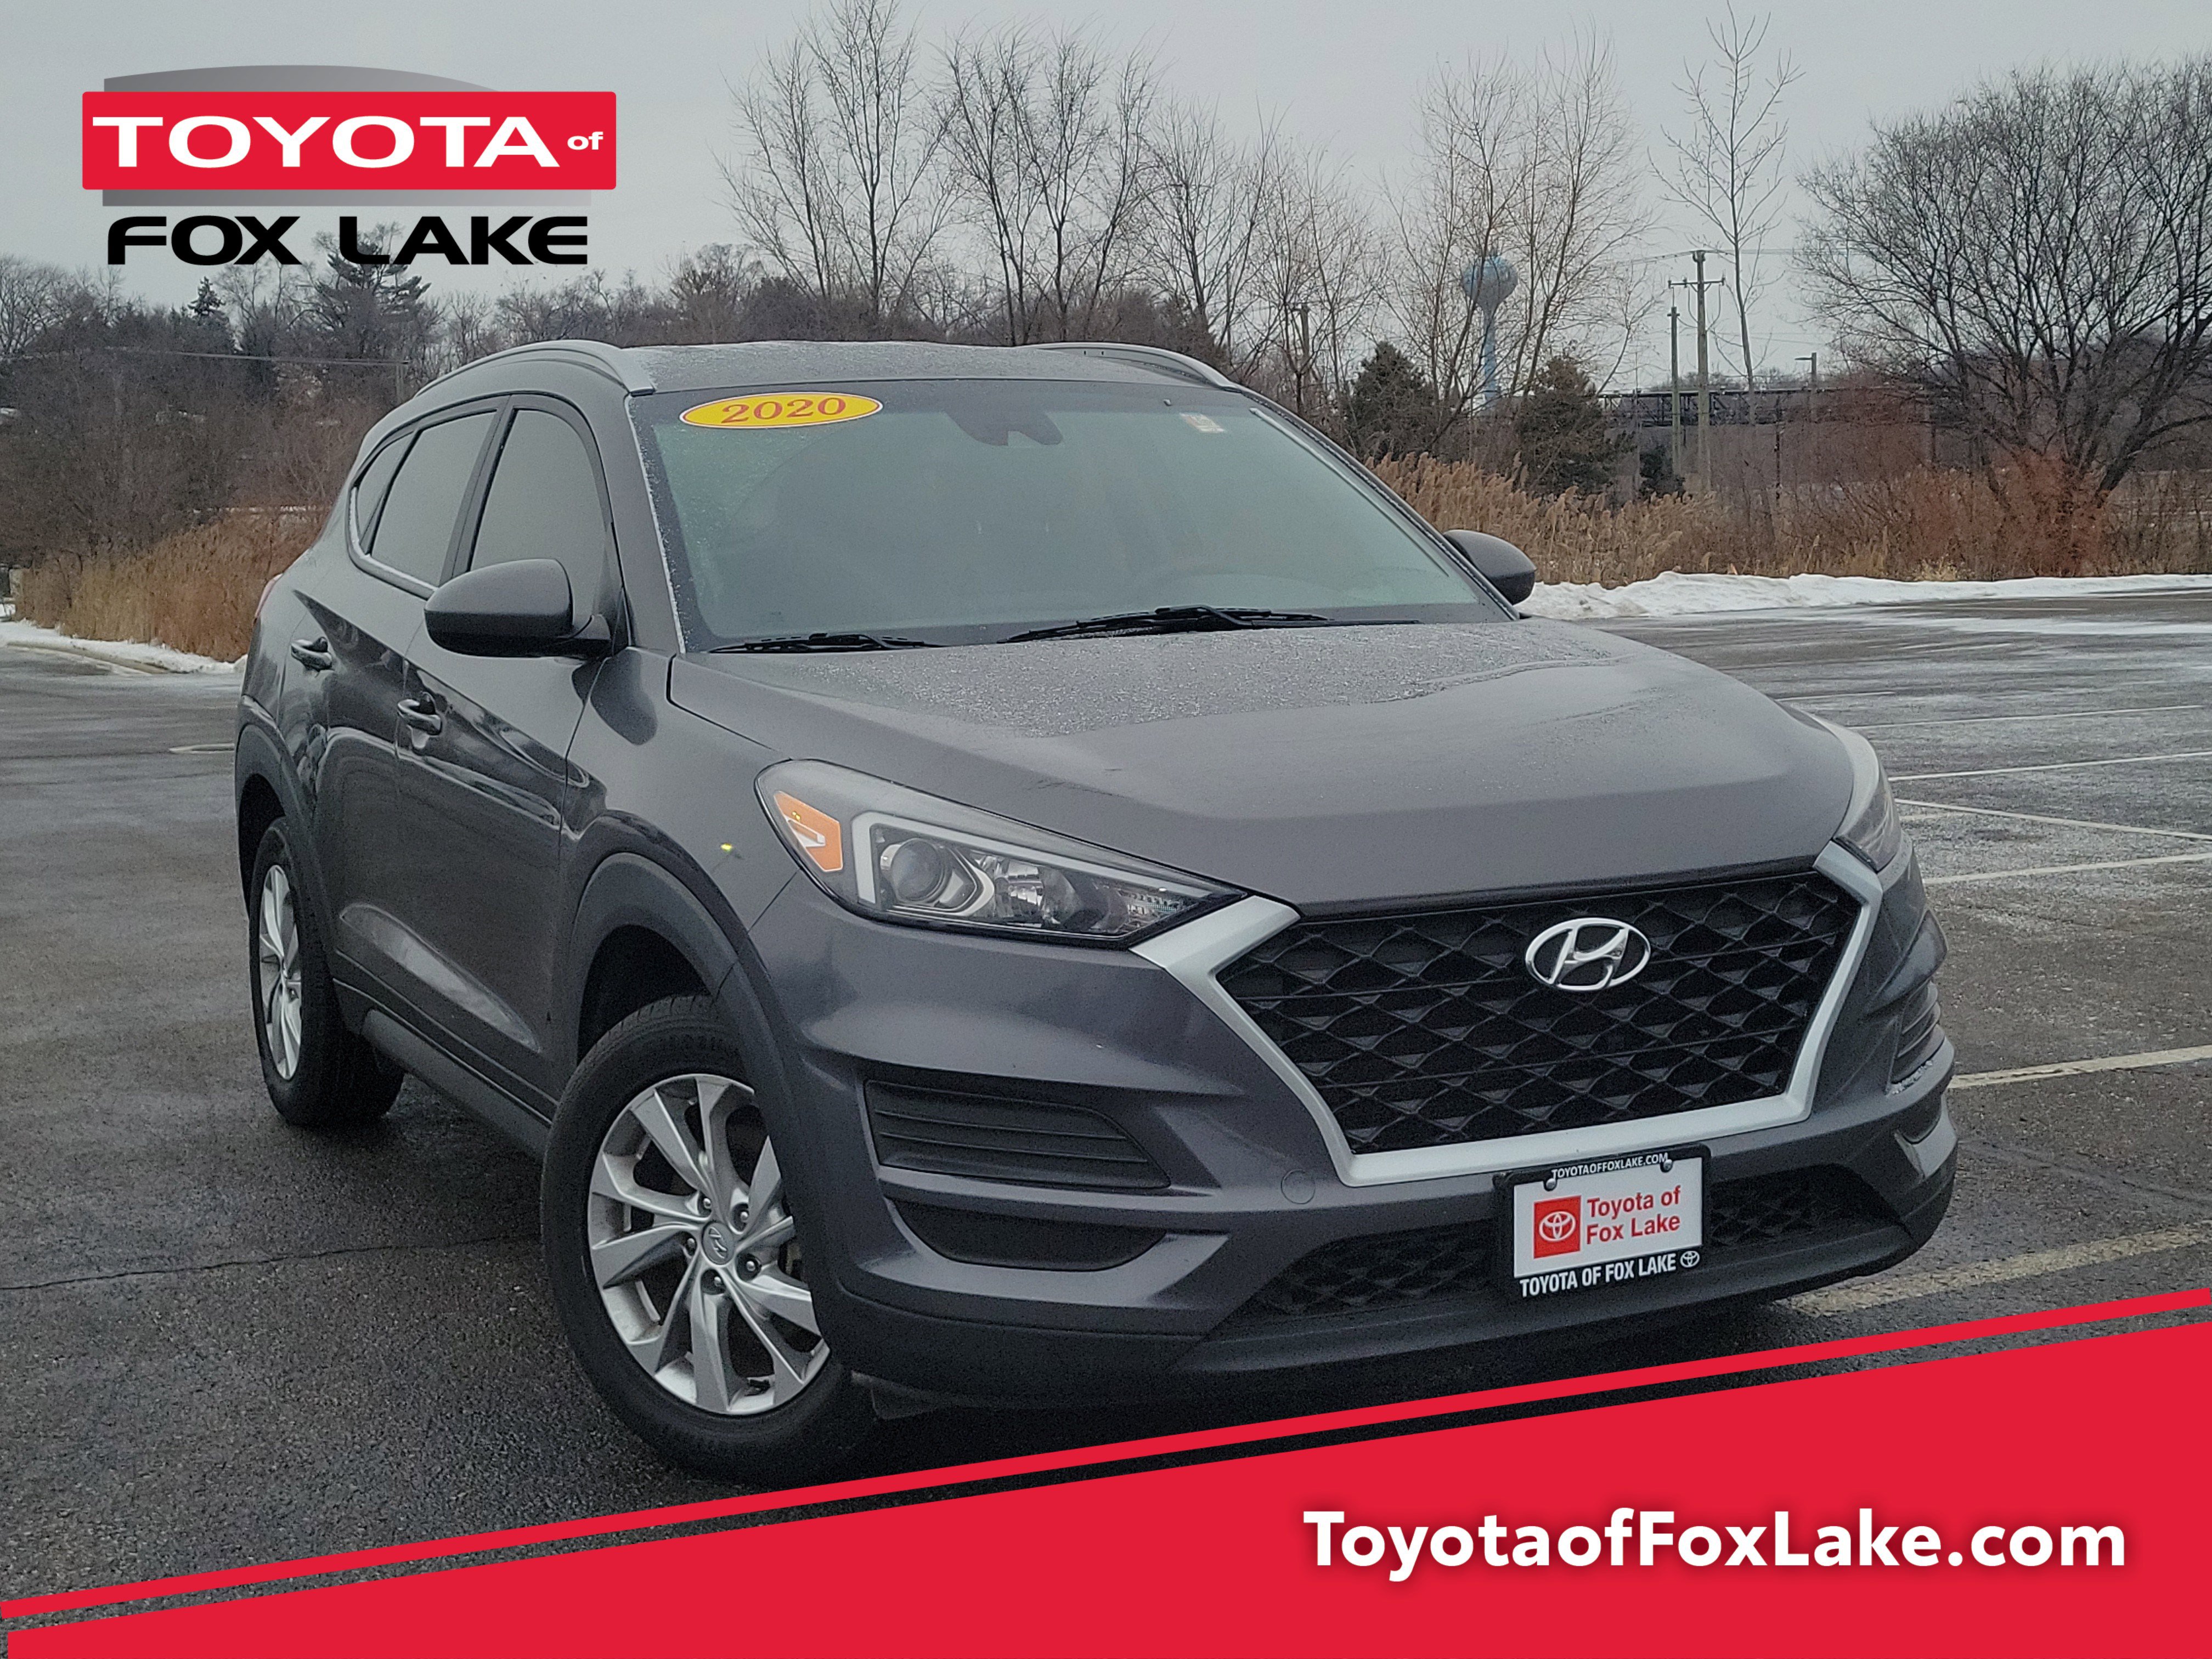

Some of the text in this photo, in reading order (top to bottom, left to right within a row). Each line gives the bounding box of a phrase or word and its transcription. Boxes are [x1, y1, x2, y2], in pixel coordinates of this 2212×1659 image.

[721, 398, 846, 424] 2020
[1551, 1152, 1668, 1179] TOYOTAOFFOXLAKE.COM
[1587, 1186, 1681, 1220] Toyota of
[1587, 1214, 1680, 1244] Fox Lake
[1519, 1253, 1677, 1297] TOYOTA OF FOX LAKE
